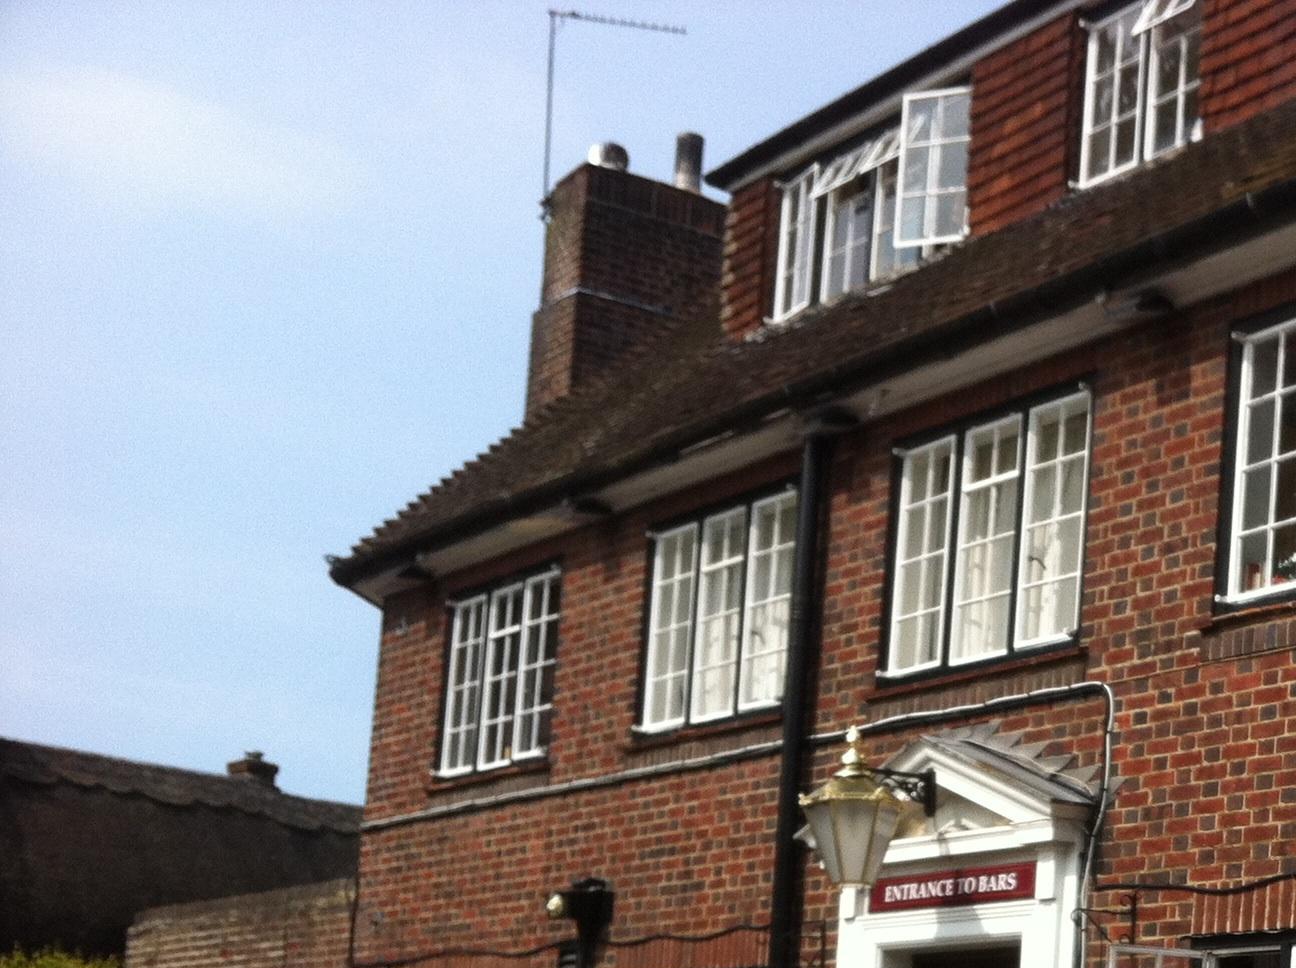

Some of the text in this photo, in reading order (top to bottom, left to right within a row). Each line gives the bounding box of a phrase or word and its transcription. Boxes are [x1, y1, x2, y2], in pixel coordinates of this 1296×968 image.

[884, 872, 1018, 902] ENTRANCE TO BARS
